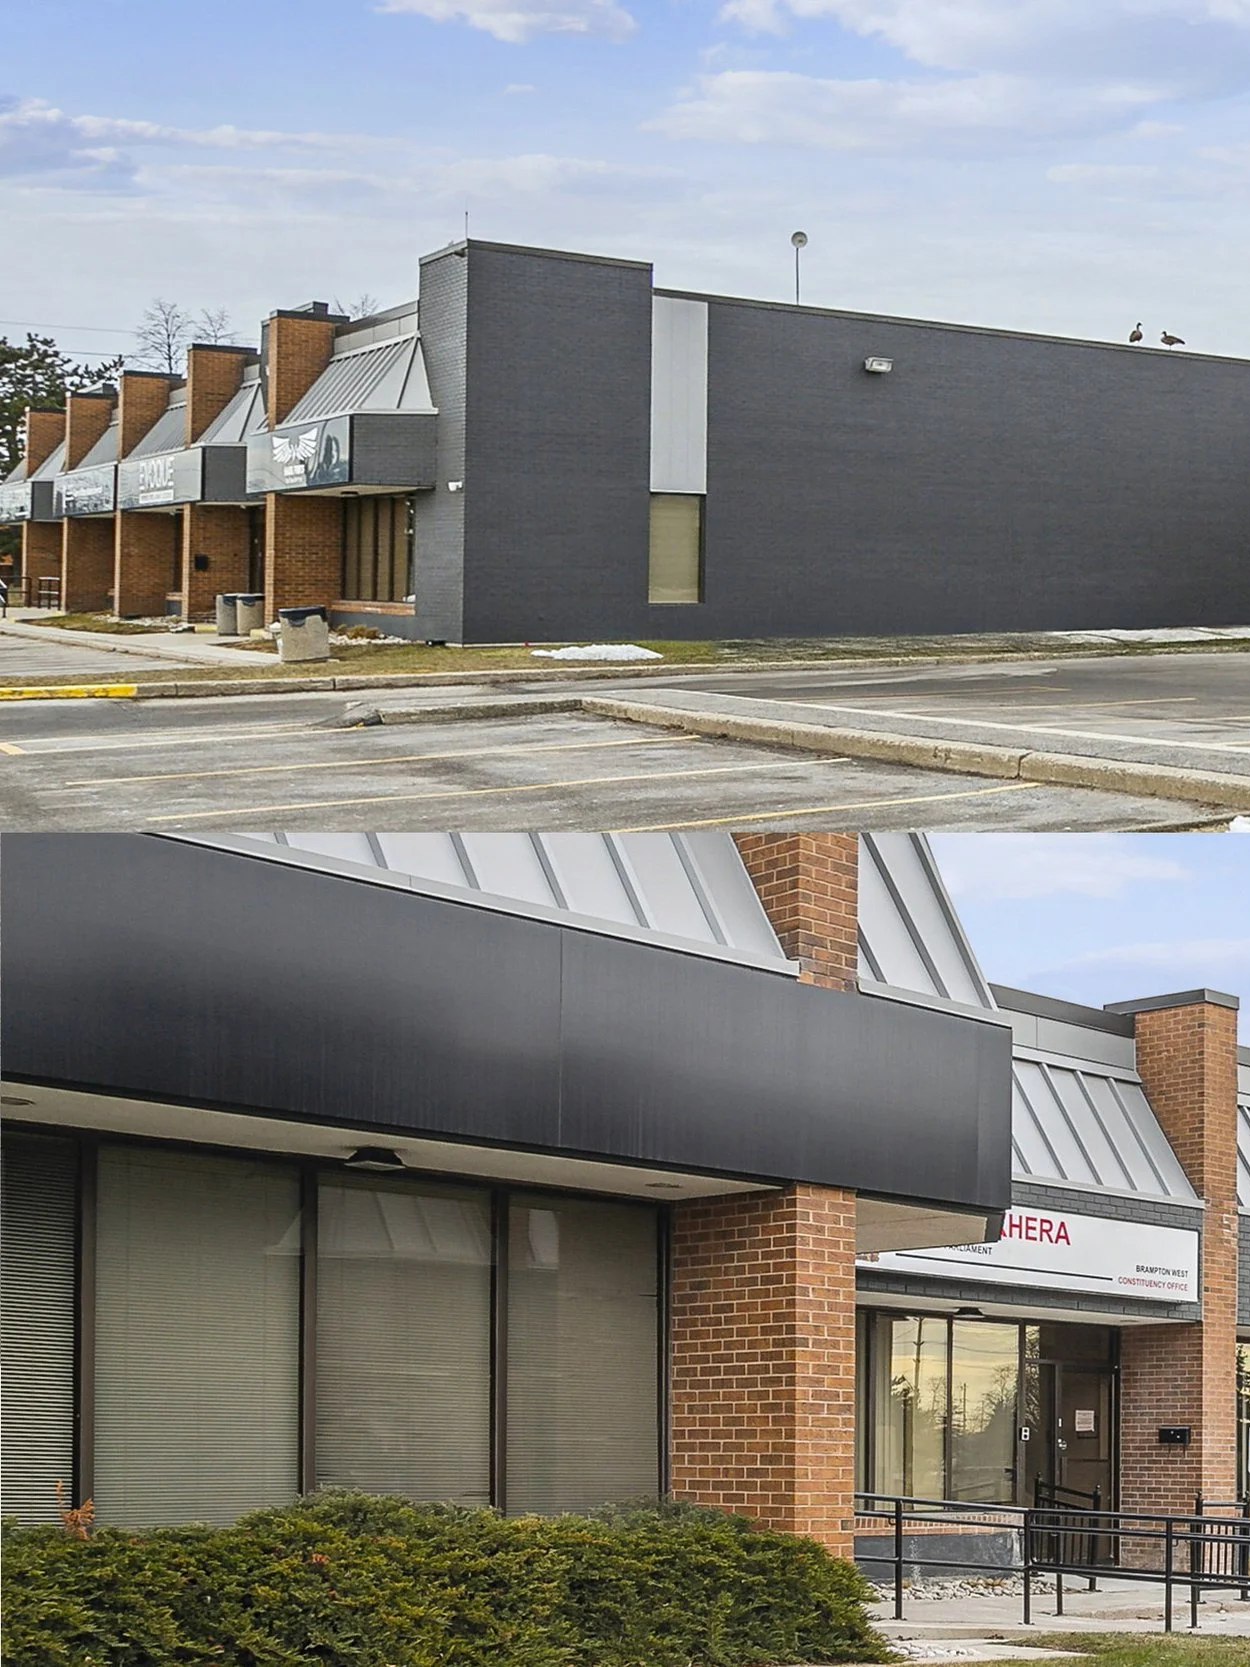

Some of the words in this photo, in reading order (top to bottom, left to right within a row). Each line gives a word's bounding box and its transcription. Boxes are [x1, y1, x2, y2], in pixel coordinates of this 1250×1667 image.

[1136, 1265, 1170, 1276] BRAMPTON
[1172, 1269, 1188, 1278] WEST
[1118, 1276, 1166, 1289] CONSTITUENCY
[1167, 1282, 1188, 1291] OFFICE
